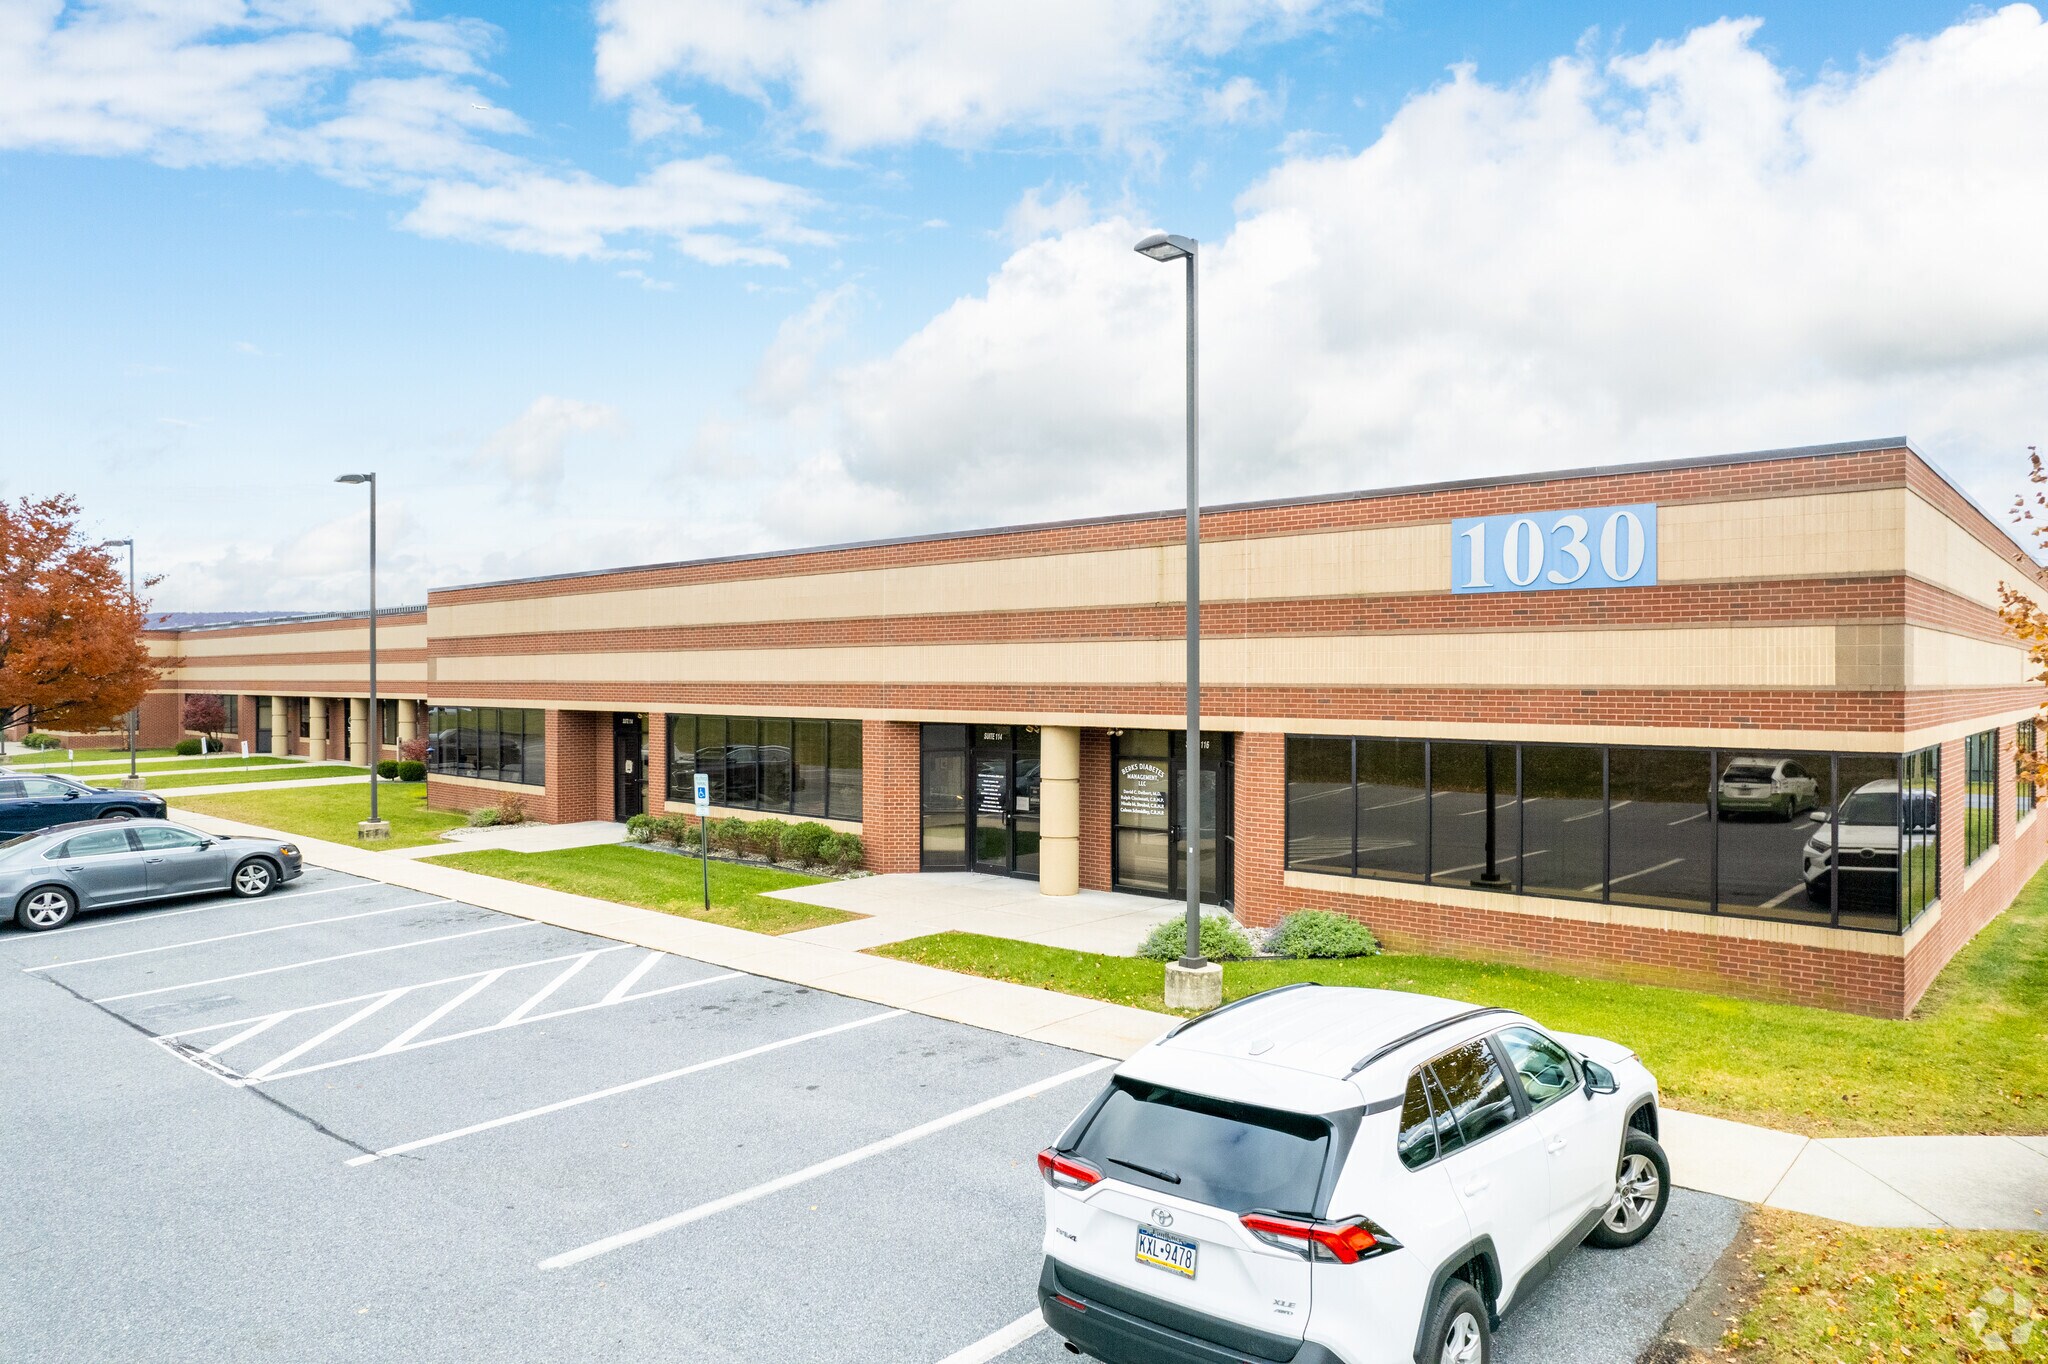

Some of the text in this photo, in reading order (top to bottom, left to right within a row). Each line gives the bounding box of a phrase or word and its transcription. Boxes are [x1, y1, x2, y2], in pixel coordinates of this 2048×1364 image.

[1461, 511, 1645, 588] 1030
[983, 732, 995, 740] SUITE
[1200, 740, 1210, 749] 116
[1121, 763, 1165, 778] BERKS DIABETES
[1273, 1299, 1296, 1309] XLE
